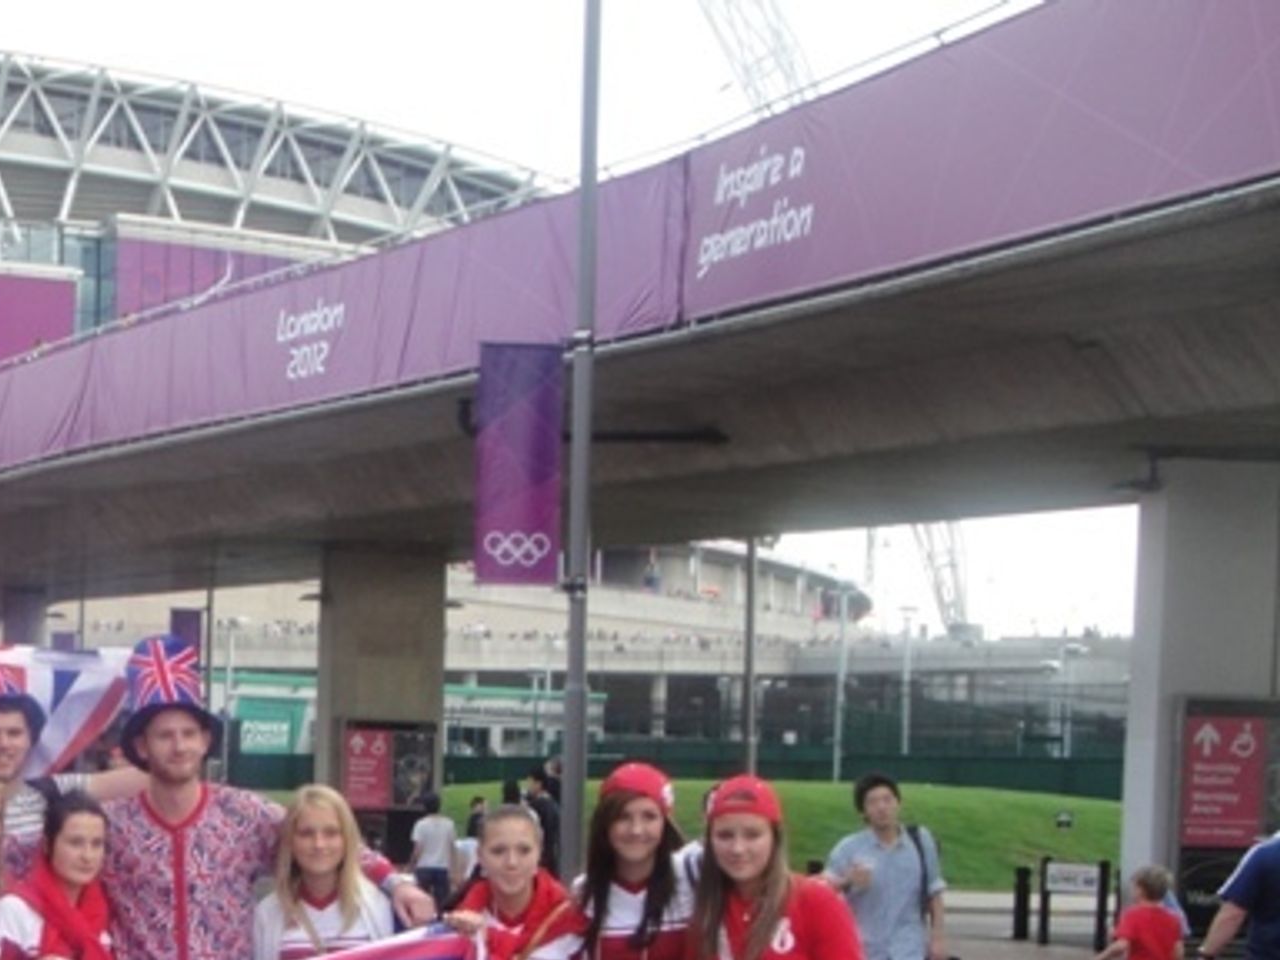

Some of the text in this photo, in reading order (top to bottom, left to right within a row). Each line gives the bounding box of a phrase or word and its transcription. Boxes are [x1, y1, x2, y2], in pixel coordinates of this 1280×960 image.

[714, 143, 805, 207] Inspire a
[696, 196, 815, 279] generation
[276, 297, 345, 342] London
[286, 340, 329, 380] 2012
